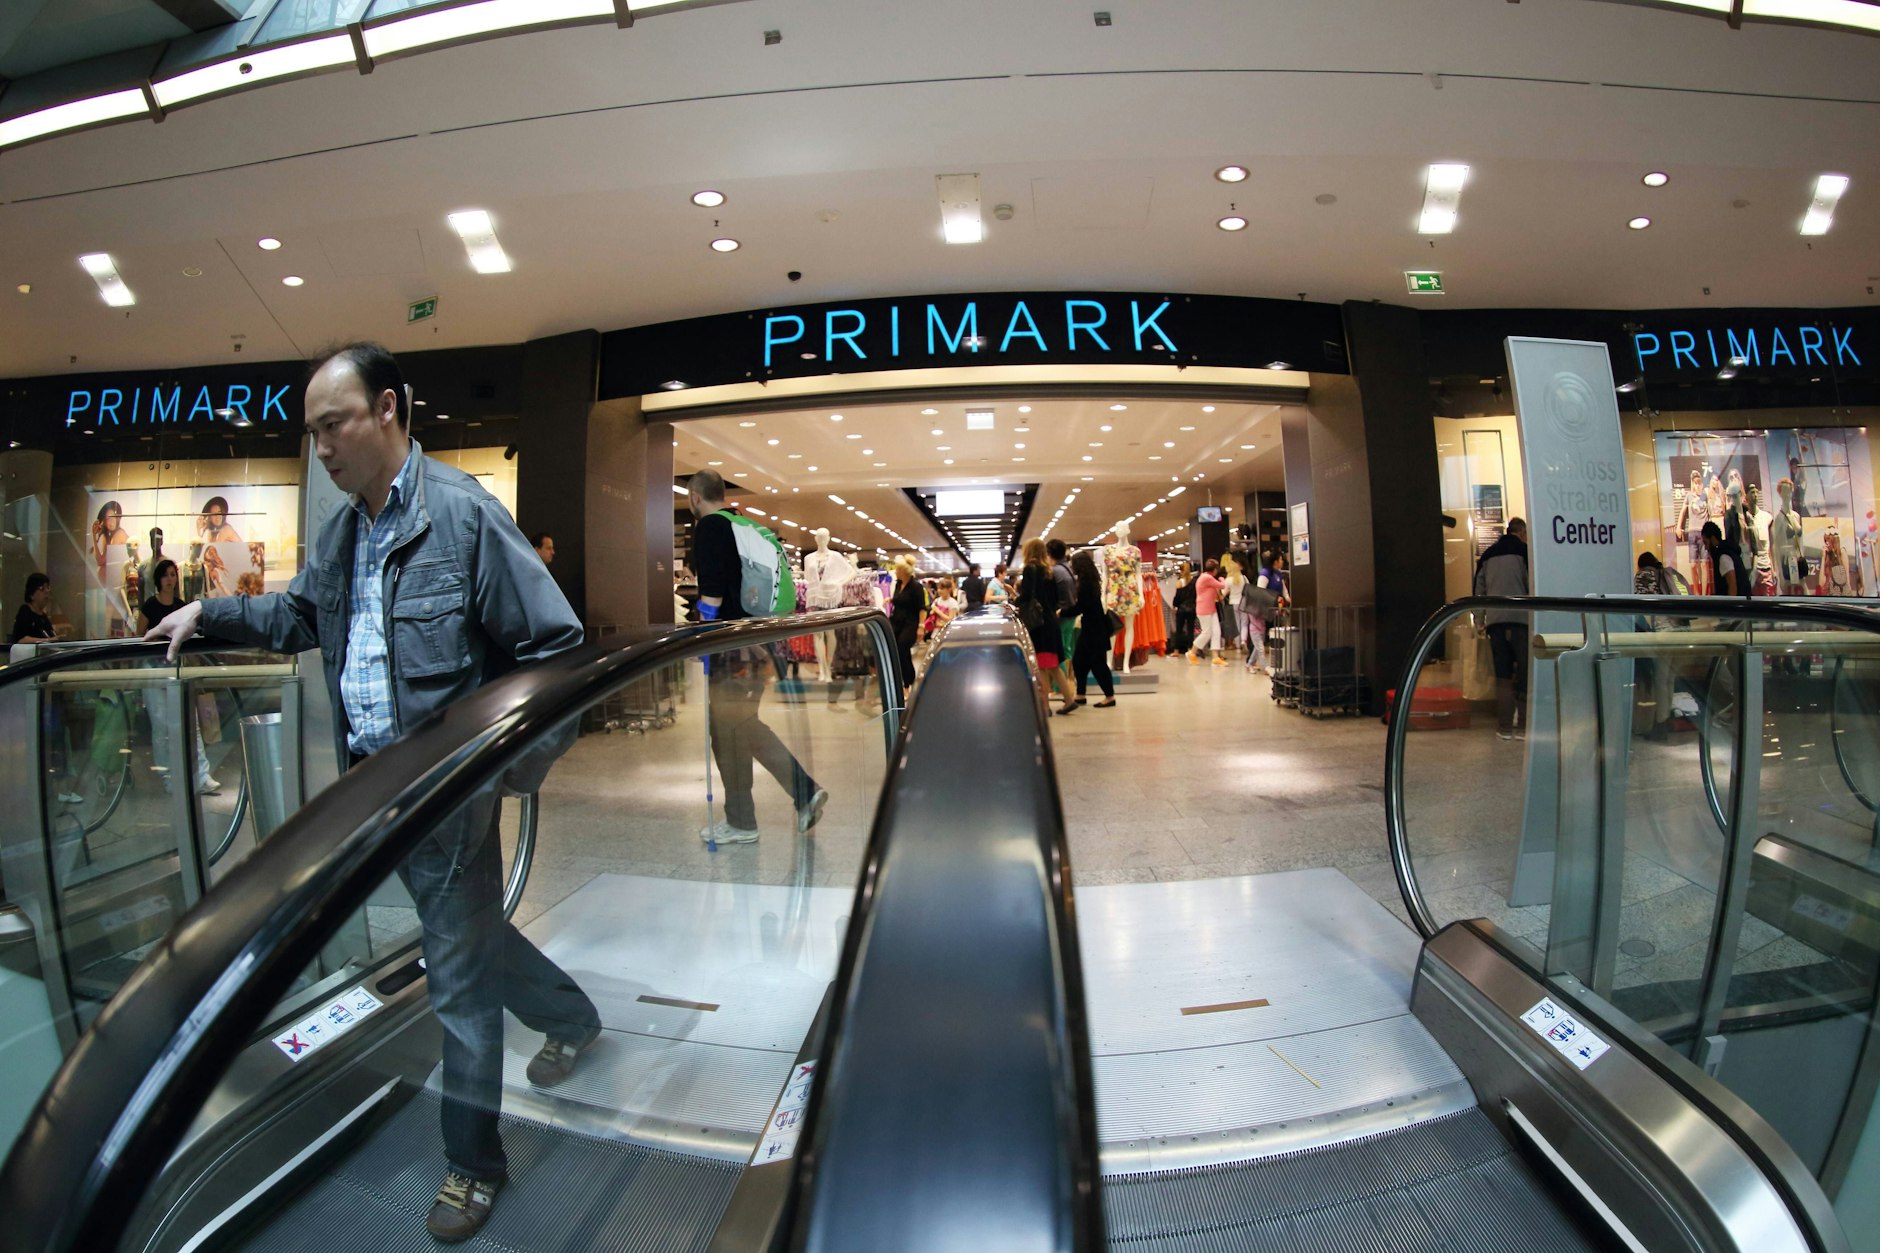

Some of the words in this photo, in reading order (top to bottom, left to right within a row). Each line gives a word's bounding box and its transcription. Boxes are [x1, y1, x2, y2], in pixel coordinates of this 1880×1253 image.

[763, 299, 1179, 368] PRIMARK
[1633, 326, 1862, 371] PRIMARK
[65, 384, 291, 428] PRIMARK
[1546, 480, 1620, 513] Straßen
[1552, 514, 1617, 545] Center
